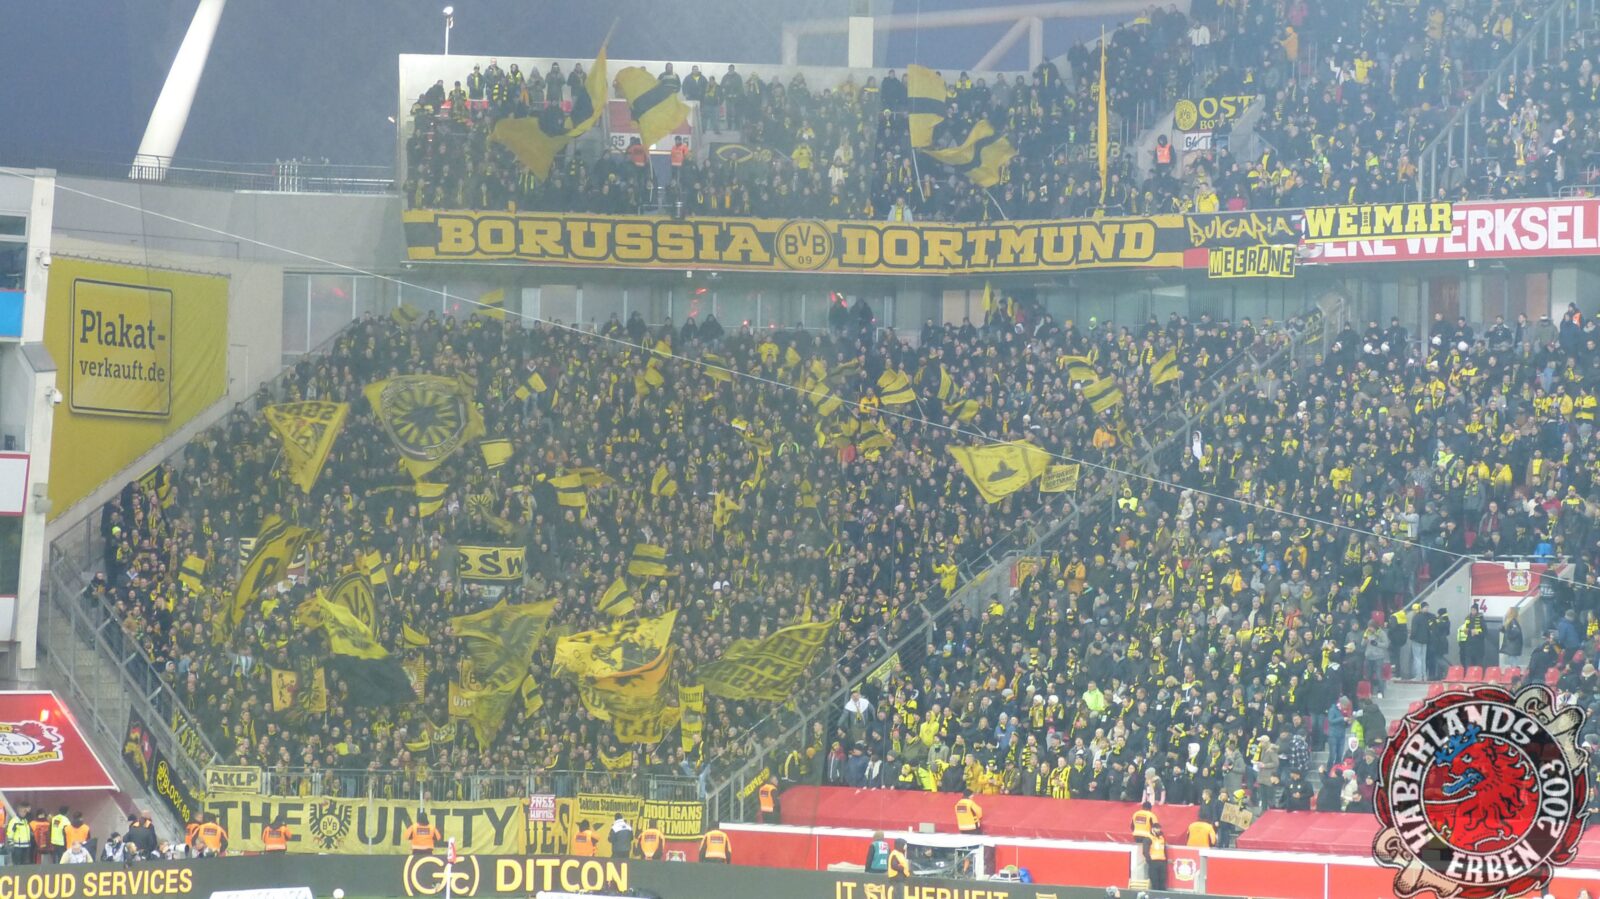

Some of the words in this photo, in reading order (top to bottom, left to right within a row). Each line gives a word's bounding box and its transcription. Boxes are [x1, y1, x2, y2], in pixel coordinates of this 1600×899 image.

[1199, 95, 1257, 119] OST
[1305, 202, 1453, 238] WEIMAR
[437, 217, 772, 264] BORUSSIA
[841, 221, 1156, 266] DORTMUND
[785, 225, 826, 255] BVB
[798, 255, 813, 265] 09
[1209, 247, 1294, 274] MEERANE
[80, 309, 166, 350] Plakat-
[79, 357, 165, 382] verkauft.de
[210, 770, 259, 787] AKLP
[207, 800, 305, 842] THE
[356, 804, 519, 849] UNITY
[322, 816, 338, 831] BVB
[642, 816, 702, 835] DRTMUND
[643, 803, 703, 821] HOOLIGANS
[0, 871, 76, 899] CLOUD
[82, 867, 193, 898] SERVICES
[495, 857, 628, 893] DITCON
